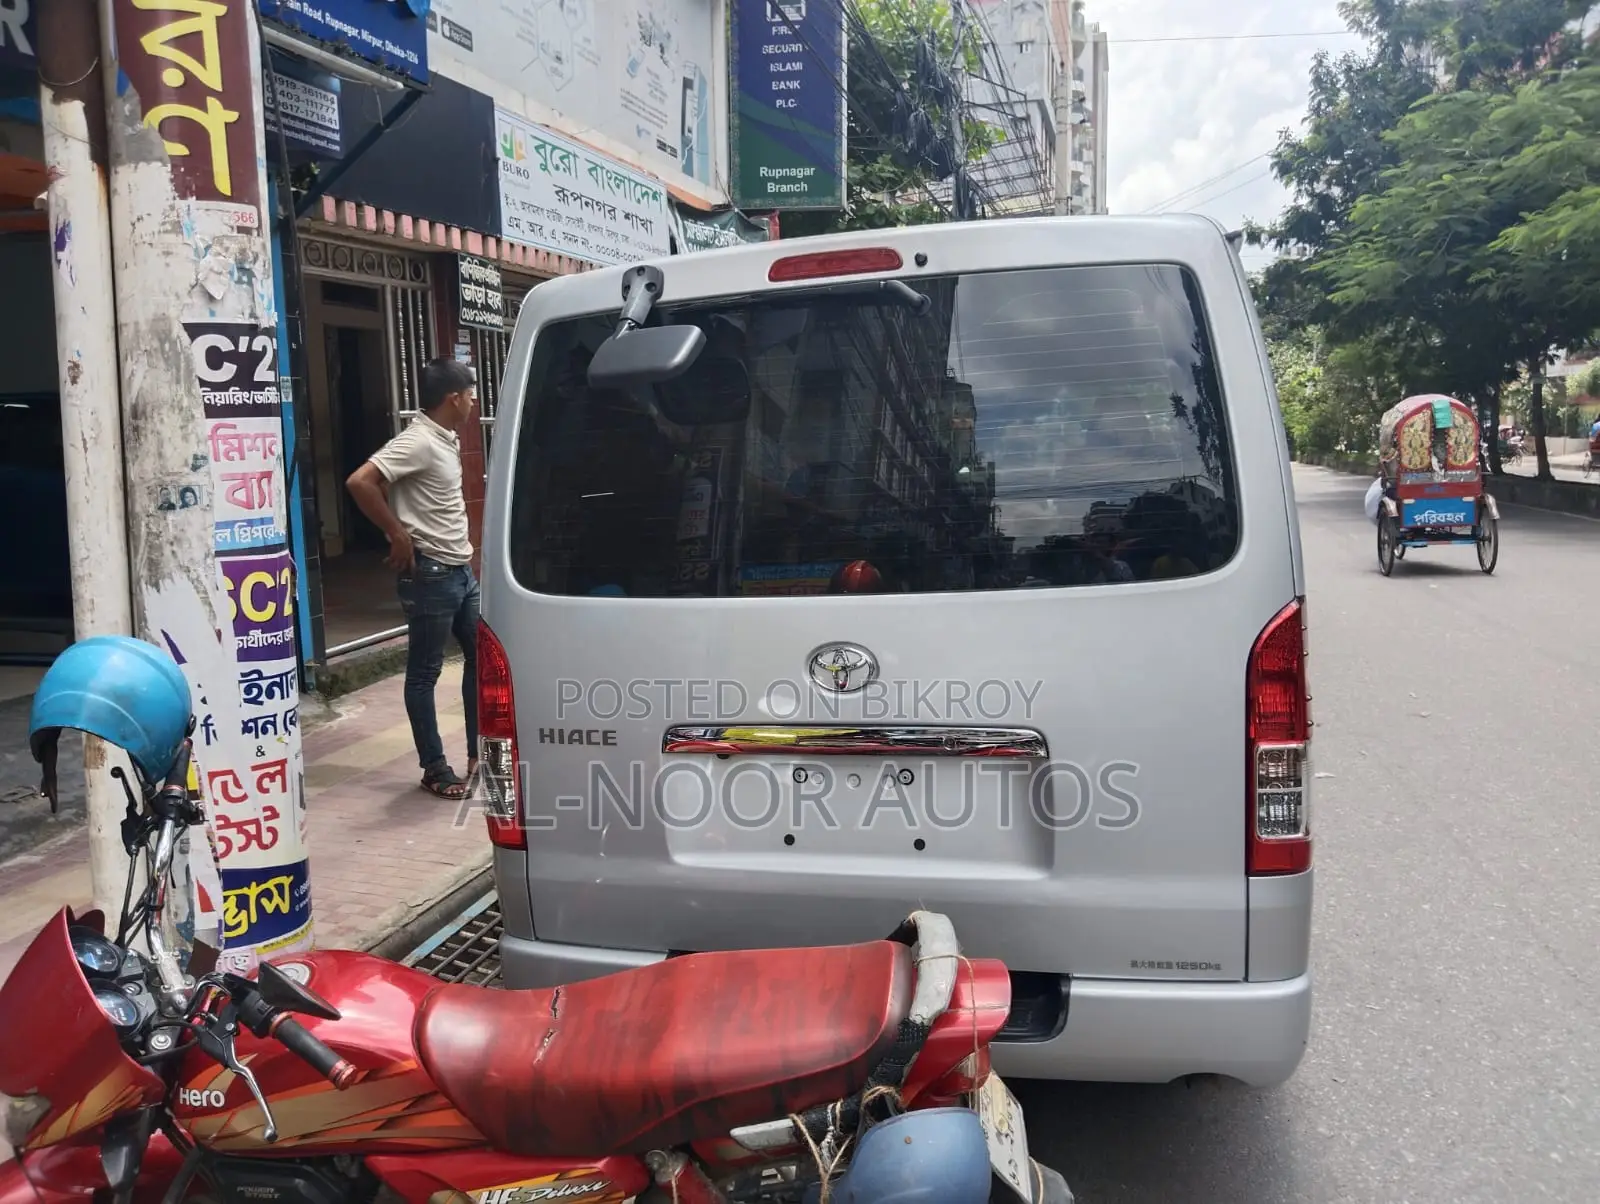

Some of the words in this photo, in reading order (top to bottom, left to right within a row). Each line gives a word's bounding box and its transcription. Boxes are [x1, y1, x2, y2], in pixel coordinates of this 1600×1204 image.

[302, 2, 324, 24] Road,
[325, 12, 361, 40] Rupnagar,
[361, 28, 385, 51] Mirpur,
[385, 40, 419, 65] Dhaka-1216
[763, 43, 808, 54] SECURIT
[770, 62, 803, 72] ISLAMI
[772, 80, 801, 90] BANK
[502, 161, 530, 180] BURO
[530, 134, 580, 180] বুরো
[585, 158, 664, 213] বাংলাদেশ
[760, 166, 816, 179] Rupnagar
[767, 181, 808, 193] Branch
[553, 184, 617, 222] রূপনগর
[622, 209, 655, 236] শাখা
[461, 282, 486, 308] ভাড়া
[1413, 509, 1466, 526] পরিবহন
[538, 727, 618, 746] HIACE
[255, 745, 266, 757] &
[179, 1087, 225, 1107] Hero
[525, 1180, 612, 1203] Deluxe
